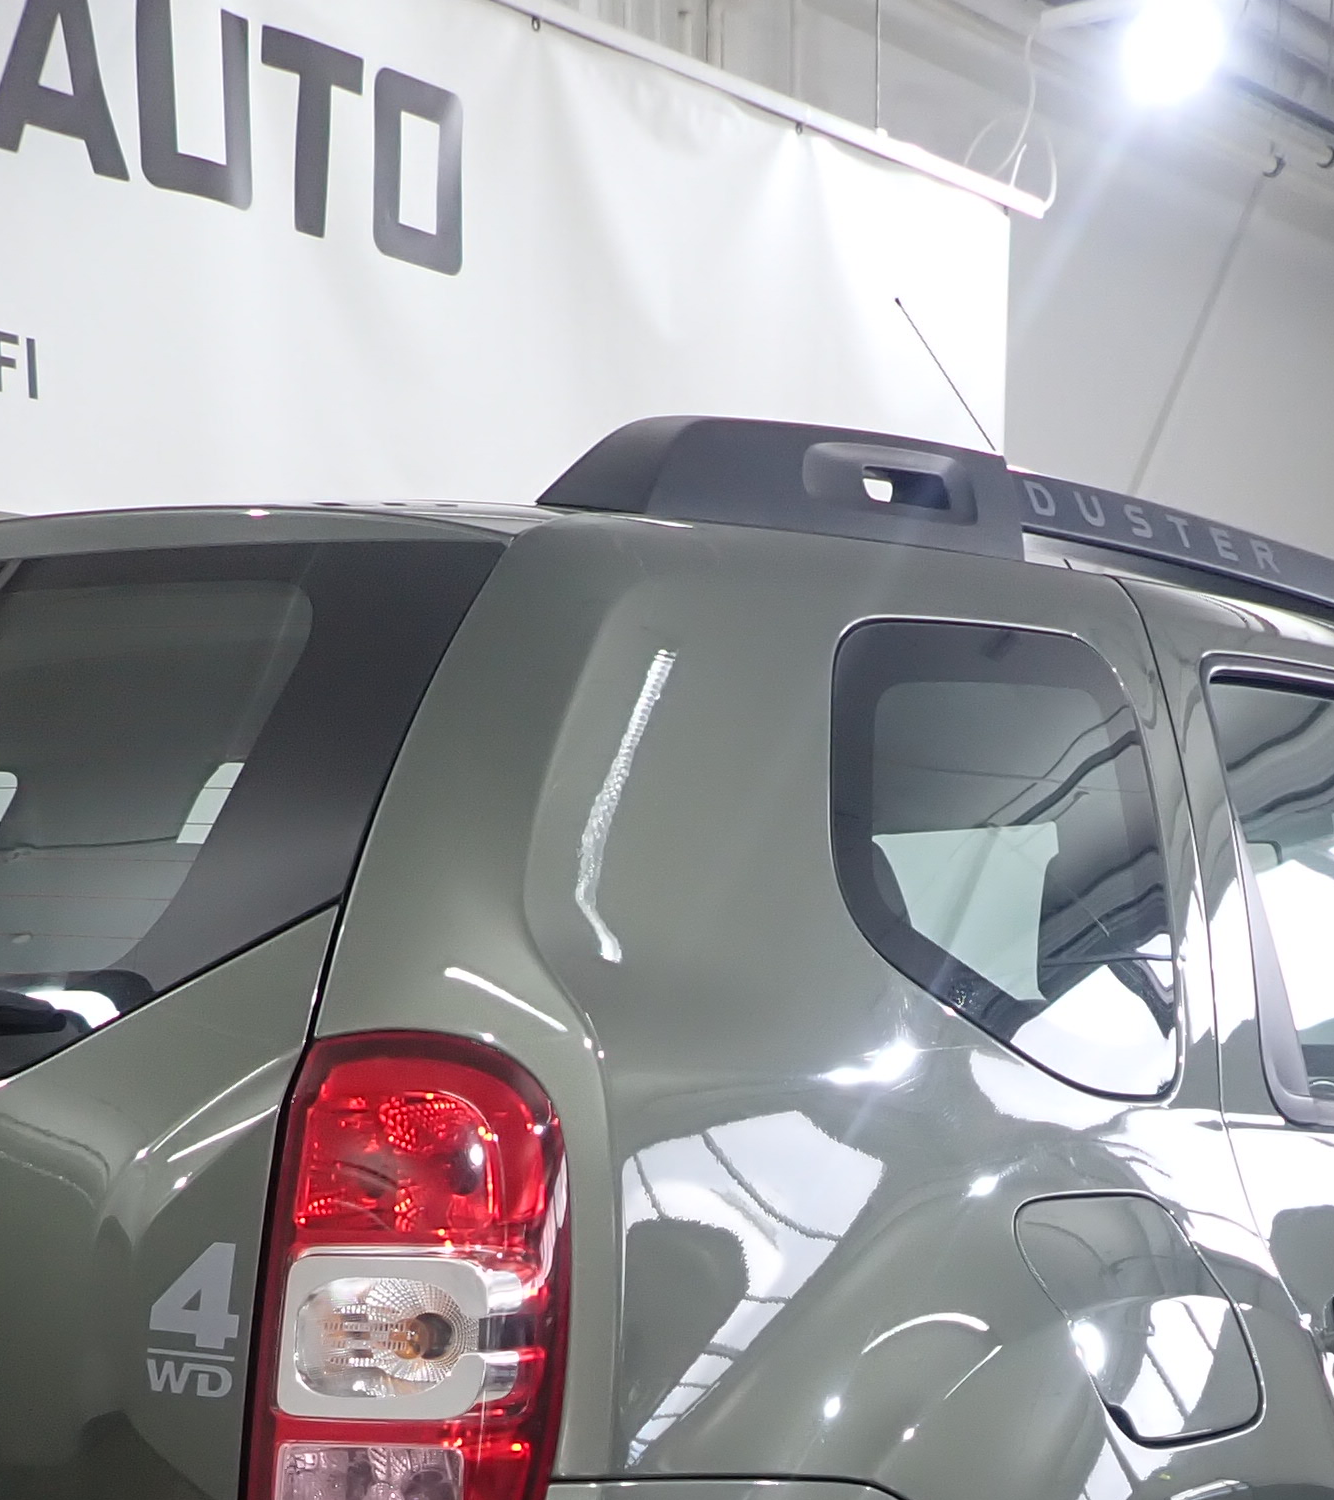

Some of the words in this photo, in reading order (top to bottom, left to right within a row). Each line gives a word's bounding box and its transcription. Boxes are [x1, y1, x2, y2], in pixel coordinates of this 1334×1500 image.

[1022, 478, 1281, 574] DUSTER
[149, 1241, 240, 1350] 4
[146, 1357, 233, 1399] WD
